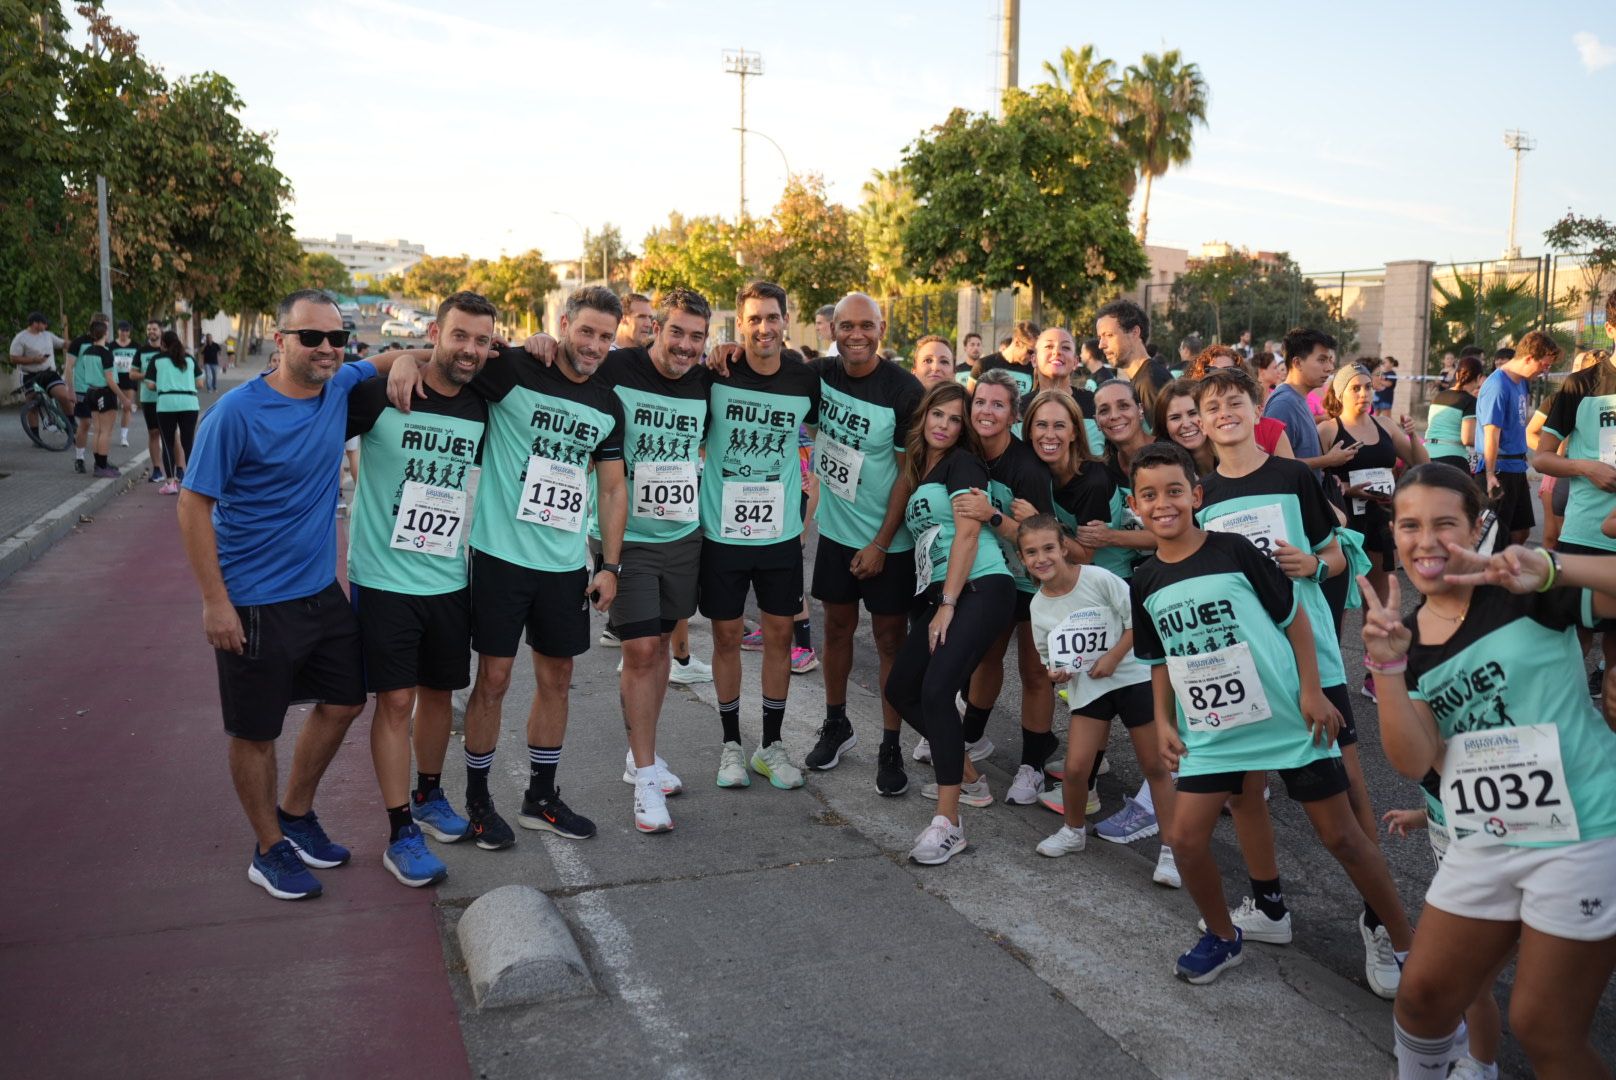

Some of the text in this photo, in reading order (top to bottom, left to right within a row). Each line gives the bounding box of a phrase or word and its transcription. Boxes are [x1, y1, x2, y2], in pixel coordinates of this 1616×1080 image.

[530, 410, 599, 443] MUJER
[633, 408, 698, 433] MUJER
[725, 404, 795, 428] MUJER
[401, 430, 475, 458] MUJER
[820, 454, 849, 484] 828
[529, 482, 583, 514] 1138
[640, 484, 695, 505] 1030
[403, 508, 460, 537] 1027
[734, 504, 773, 523] 842
[1158, 599, 1236, 641] MUJER
[1056, 631, 1109, 655] 1031
[1188, 678, 1246, 711] 829
[1429, 660, 1506, 721] MUJER
[1450, 769, 1561, 815] 1032
